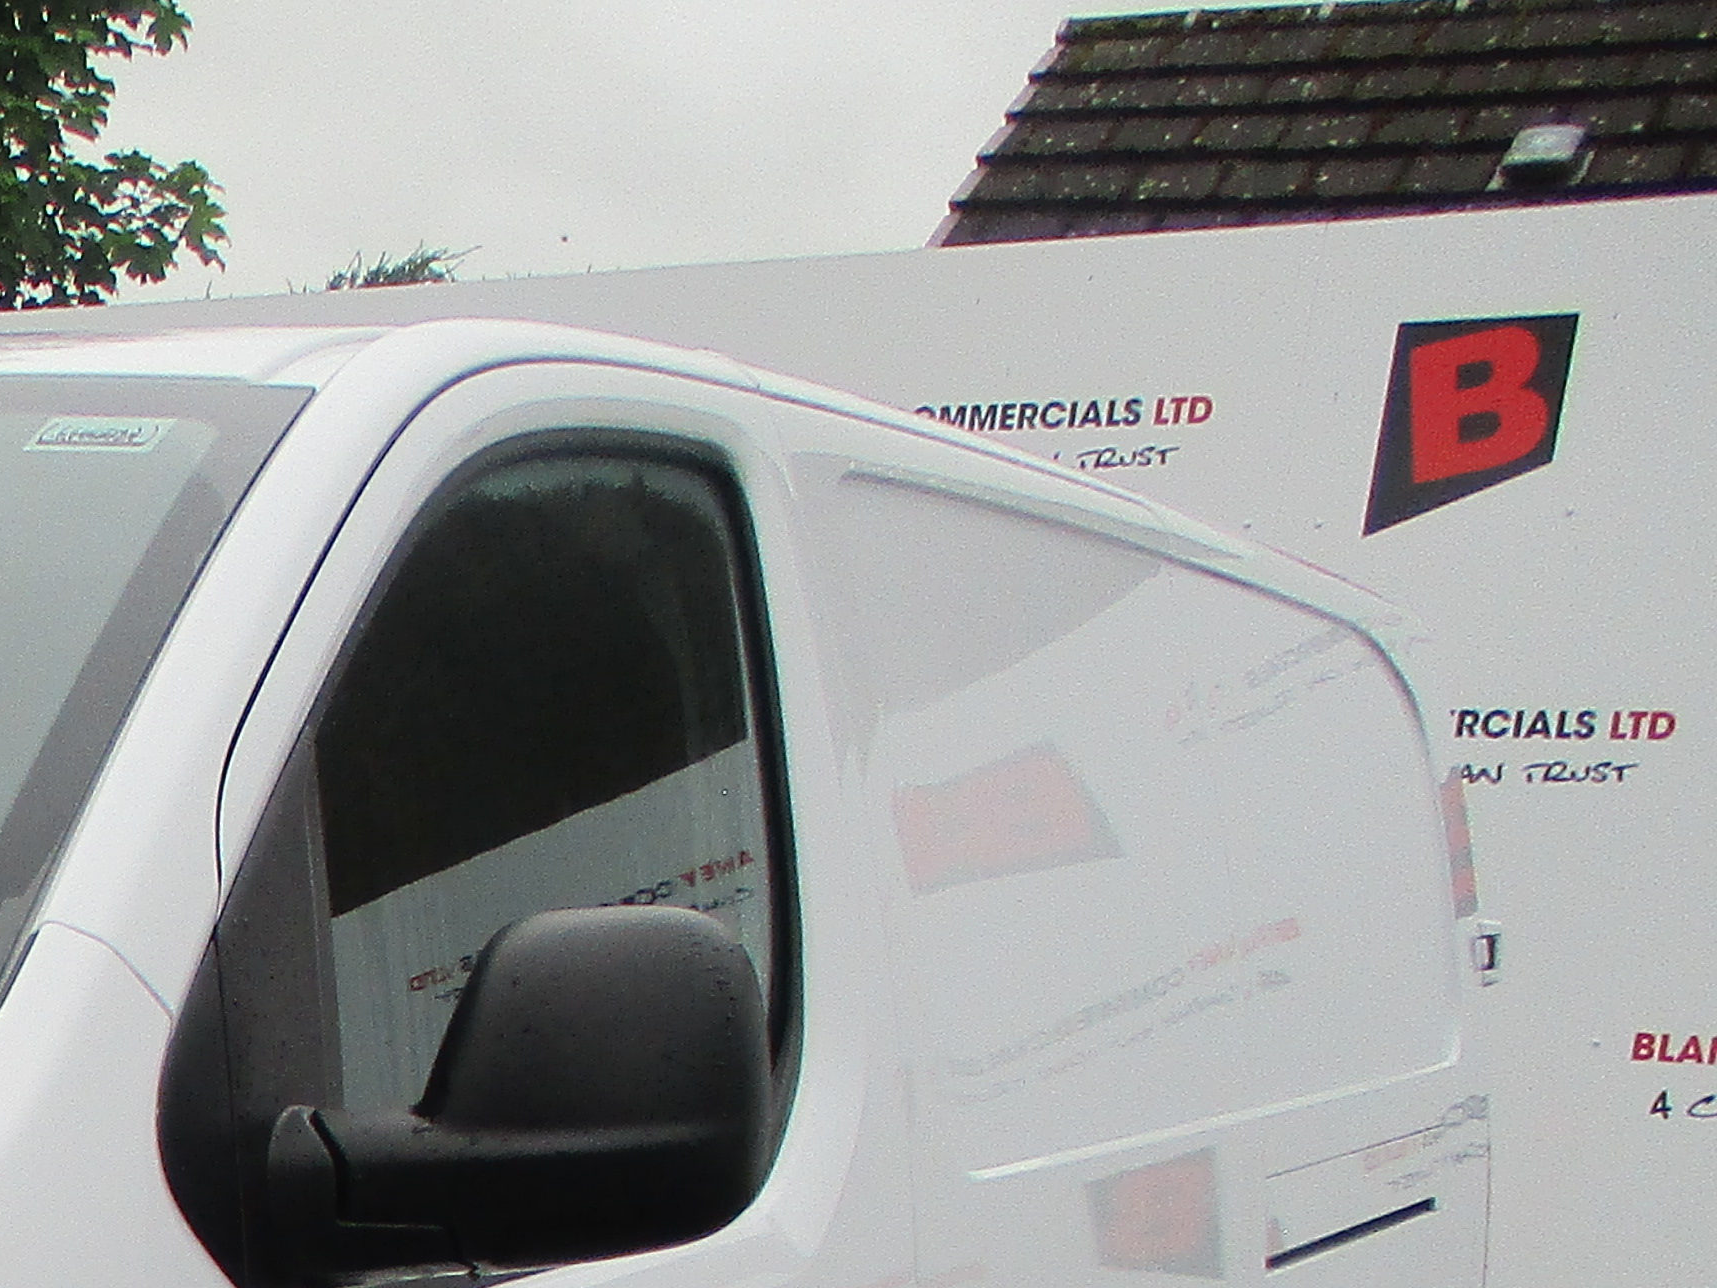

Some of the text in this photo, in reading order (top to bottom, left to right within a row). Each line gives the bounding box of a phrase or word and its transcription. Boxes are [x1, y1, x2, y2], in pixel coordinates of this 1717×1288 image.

[1153, 396, 1213, 426] LTD
[1410, 326, 1550, 484] B
[1076, 446, 1180, 470] TRUST
[1451, 709, 1676, 740] RCIALS LTD
[1520, 761, 1639, 784] TRUST
